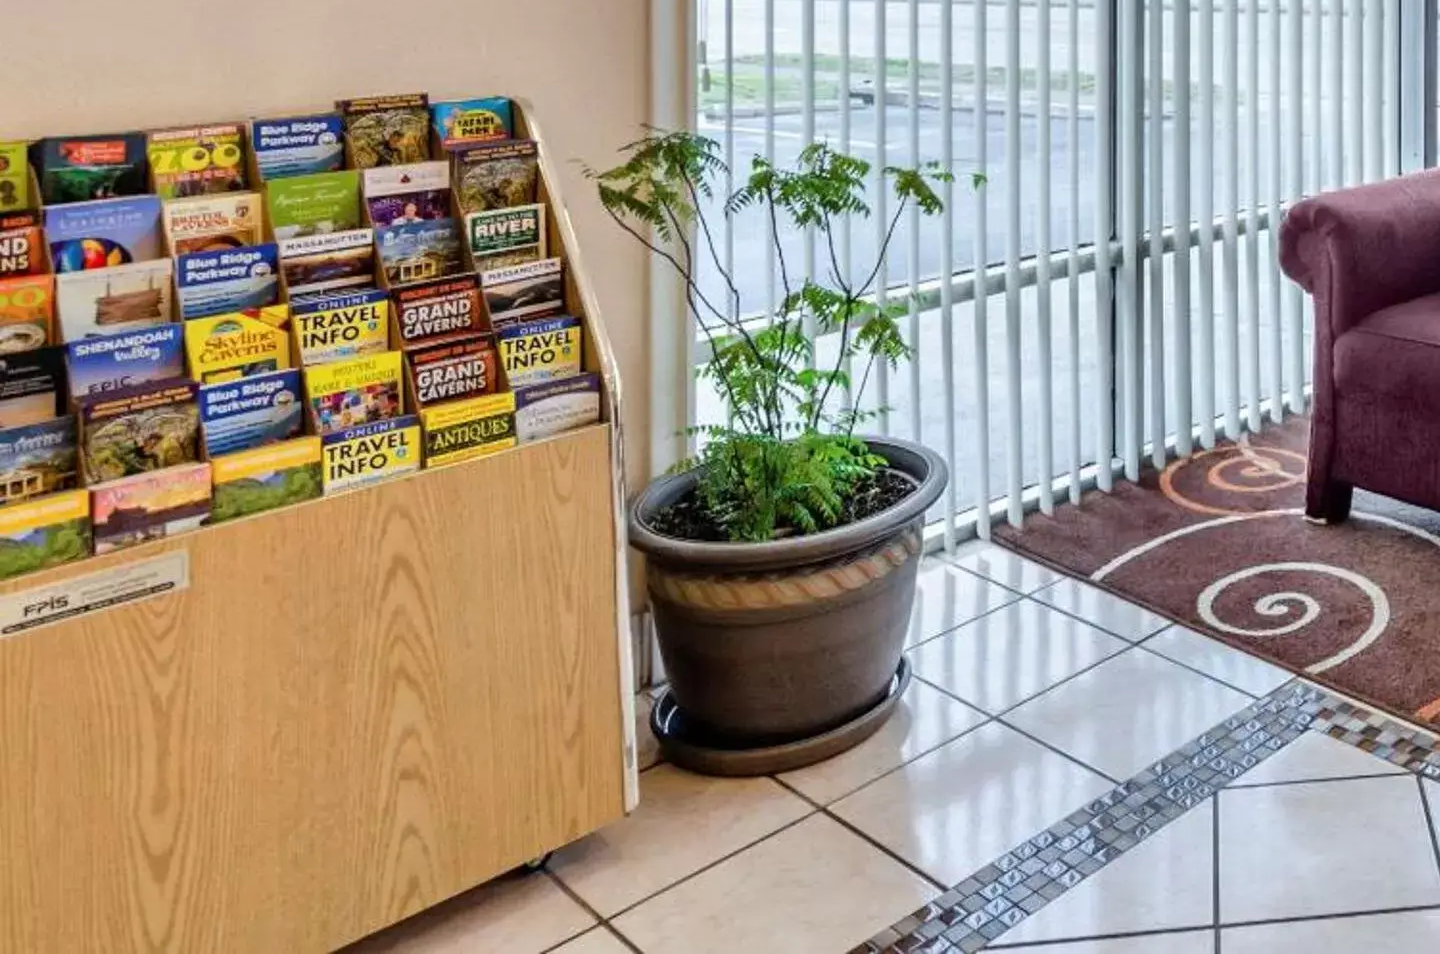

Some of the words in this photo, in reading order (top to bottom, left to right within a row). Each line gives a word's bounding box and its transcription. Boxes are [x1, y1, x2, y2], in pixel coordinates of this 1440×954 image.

[261, 125, 289, 136] Blue
[291, 122, 328, 134] Ridge
[261, 134, 316, 147] Parkway
[151, 143, 241, 175] ZOO
[475, 218, 537, 238] RIVER
[186, 258, 217, 270] Blue
[220, 251, 262, 265] Ridge
[186, 265, 248, 282] Parkway
[299, 305, 380, 331] TRAVEL
[403, 298, 471, 325] GRAND
[302, 325, 360, 349] INFO
[403, 314, 471, 339] CAVERNS
[75, 329, 174, 357] SHENANDOAH
[204, 329, 276, 350] Skyline
[504, 331, 573, 355] TRAVEL
[199, 341, 278, 364] Caverns
[506, 348, 556, 372] INFO
[417, 360, 486, 388] GRAND
[206, 389, 240, 405] Blue
[242, 379, 285, 396] Ridge
[417, 375, 487, 402] CAVERNS
[207, 395, 271, 417] Parkway
[434, 416, 510, 450] ANTIQUES
[326, 431, 409, 464] TRAVEL
[329, 452, 387, 482] INFO
